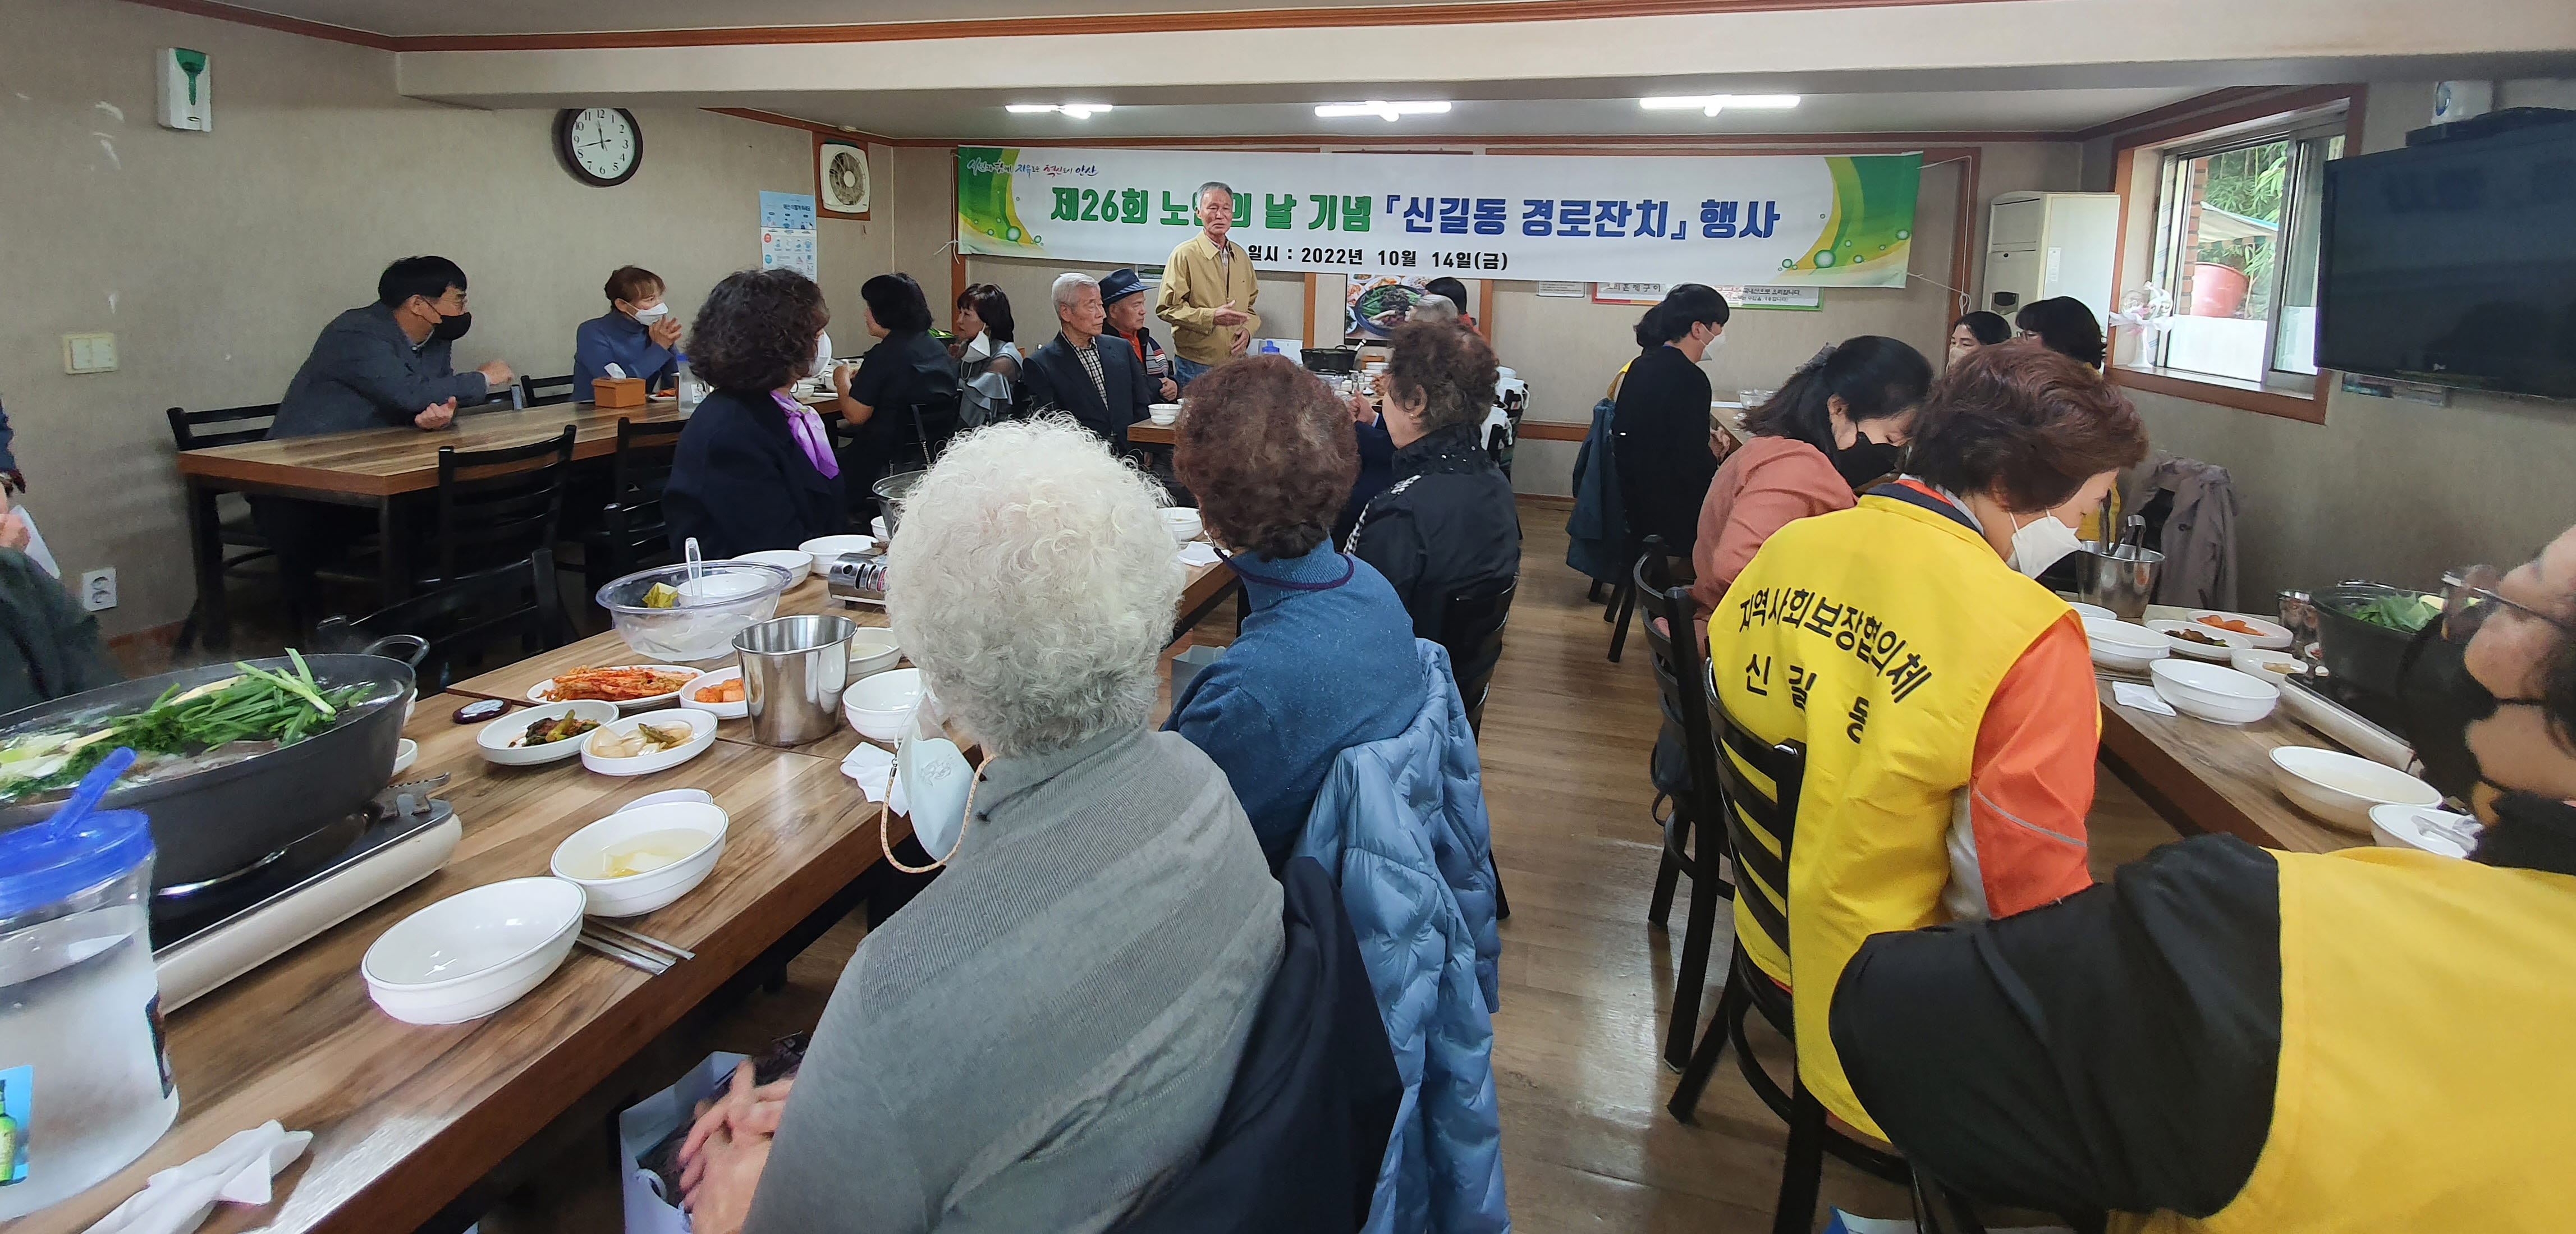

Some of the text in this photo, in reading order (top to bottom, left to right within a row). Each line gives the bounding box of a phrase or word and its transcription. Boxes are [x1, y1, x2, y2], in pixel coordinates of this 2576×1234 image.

[585, 111, 591, 121] 11
[597, 109, 605, 118] 12
[611, 114, 615, 123] 1
[575, 121, 584, 131] 10
[619, 124, 625, 134] 2
[574, 135, 580, 144] 9
[622, 139, 629, 149] 3
[577, 149, 584, 158] 8
[619, 153, 625, 162] 4
[587, 160, 592, 170] 7
[612, 162, 618, 171] 5
[1075, 164, 1099, 176] 안산
[599, 166, 606, 175] 6
[1051, 187, 1148, 224] 제26회
[1265, 193, 1296, 229] 날
[1308, 194, 1372, 232] 기념
[1386, 194, 1507, 235] 『신길동
[1522, 199, 1686, 240] 경로잔치』
[1700, 199, 1781, 238] 행사
[1248, 245, 1279, 262] 일시
[1301, 247, 1363, 265] 2022년
[1378, 250, 1417, 267] 10월
[1432, 251, 1508, 270] 14일(금)
[1739, 588, 1932, 704] 지역사회보장협의체
